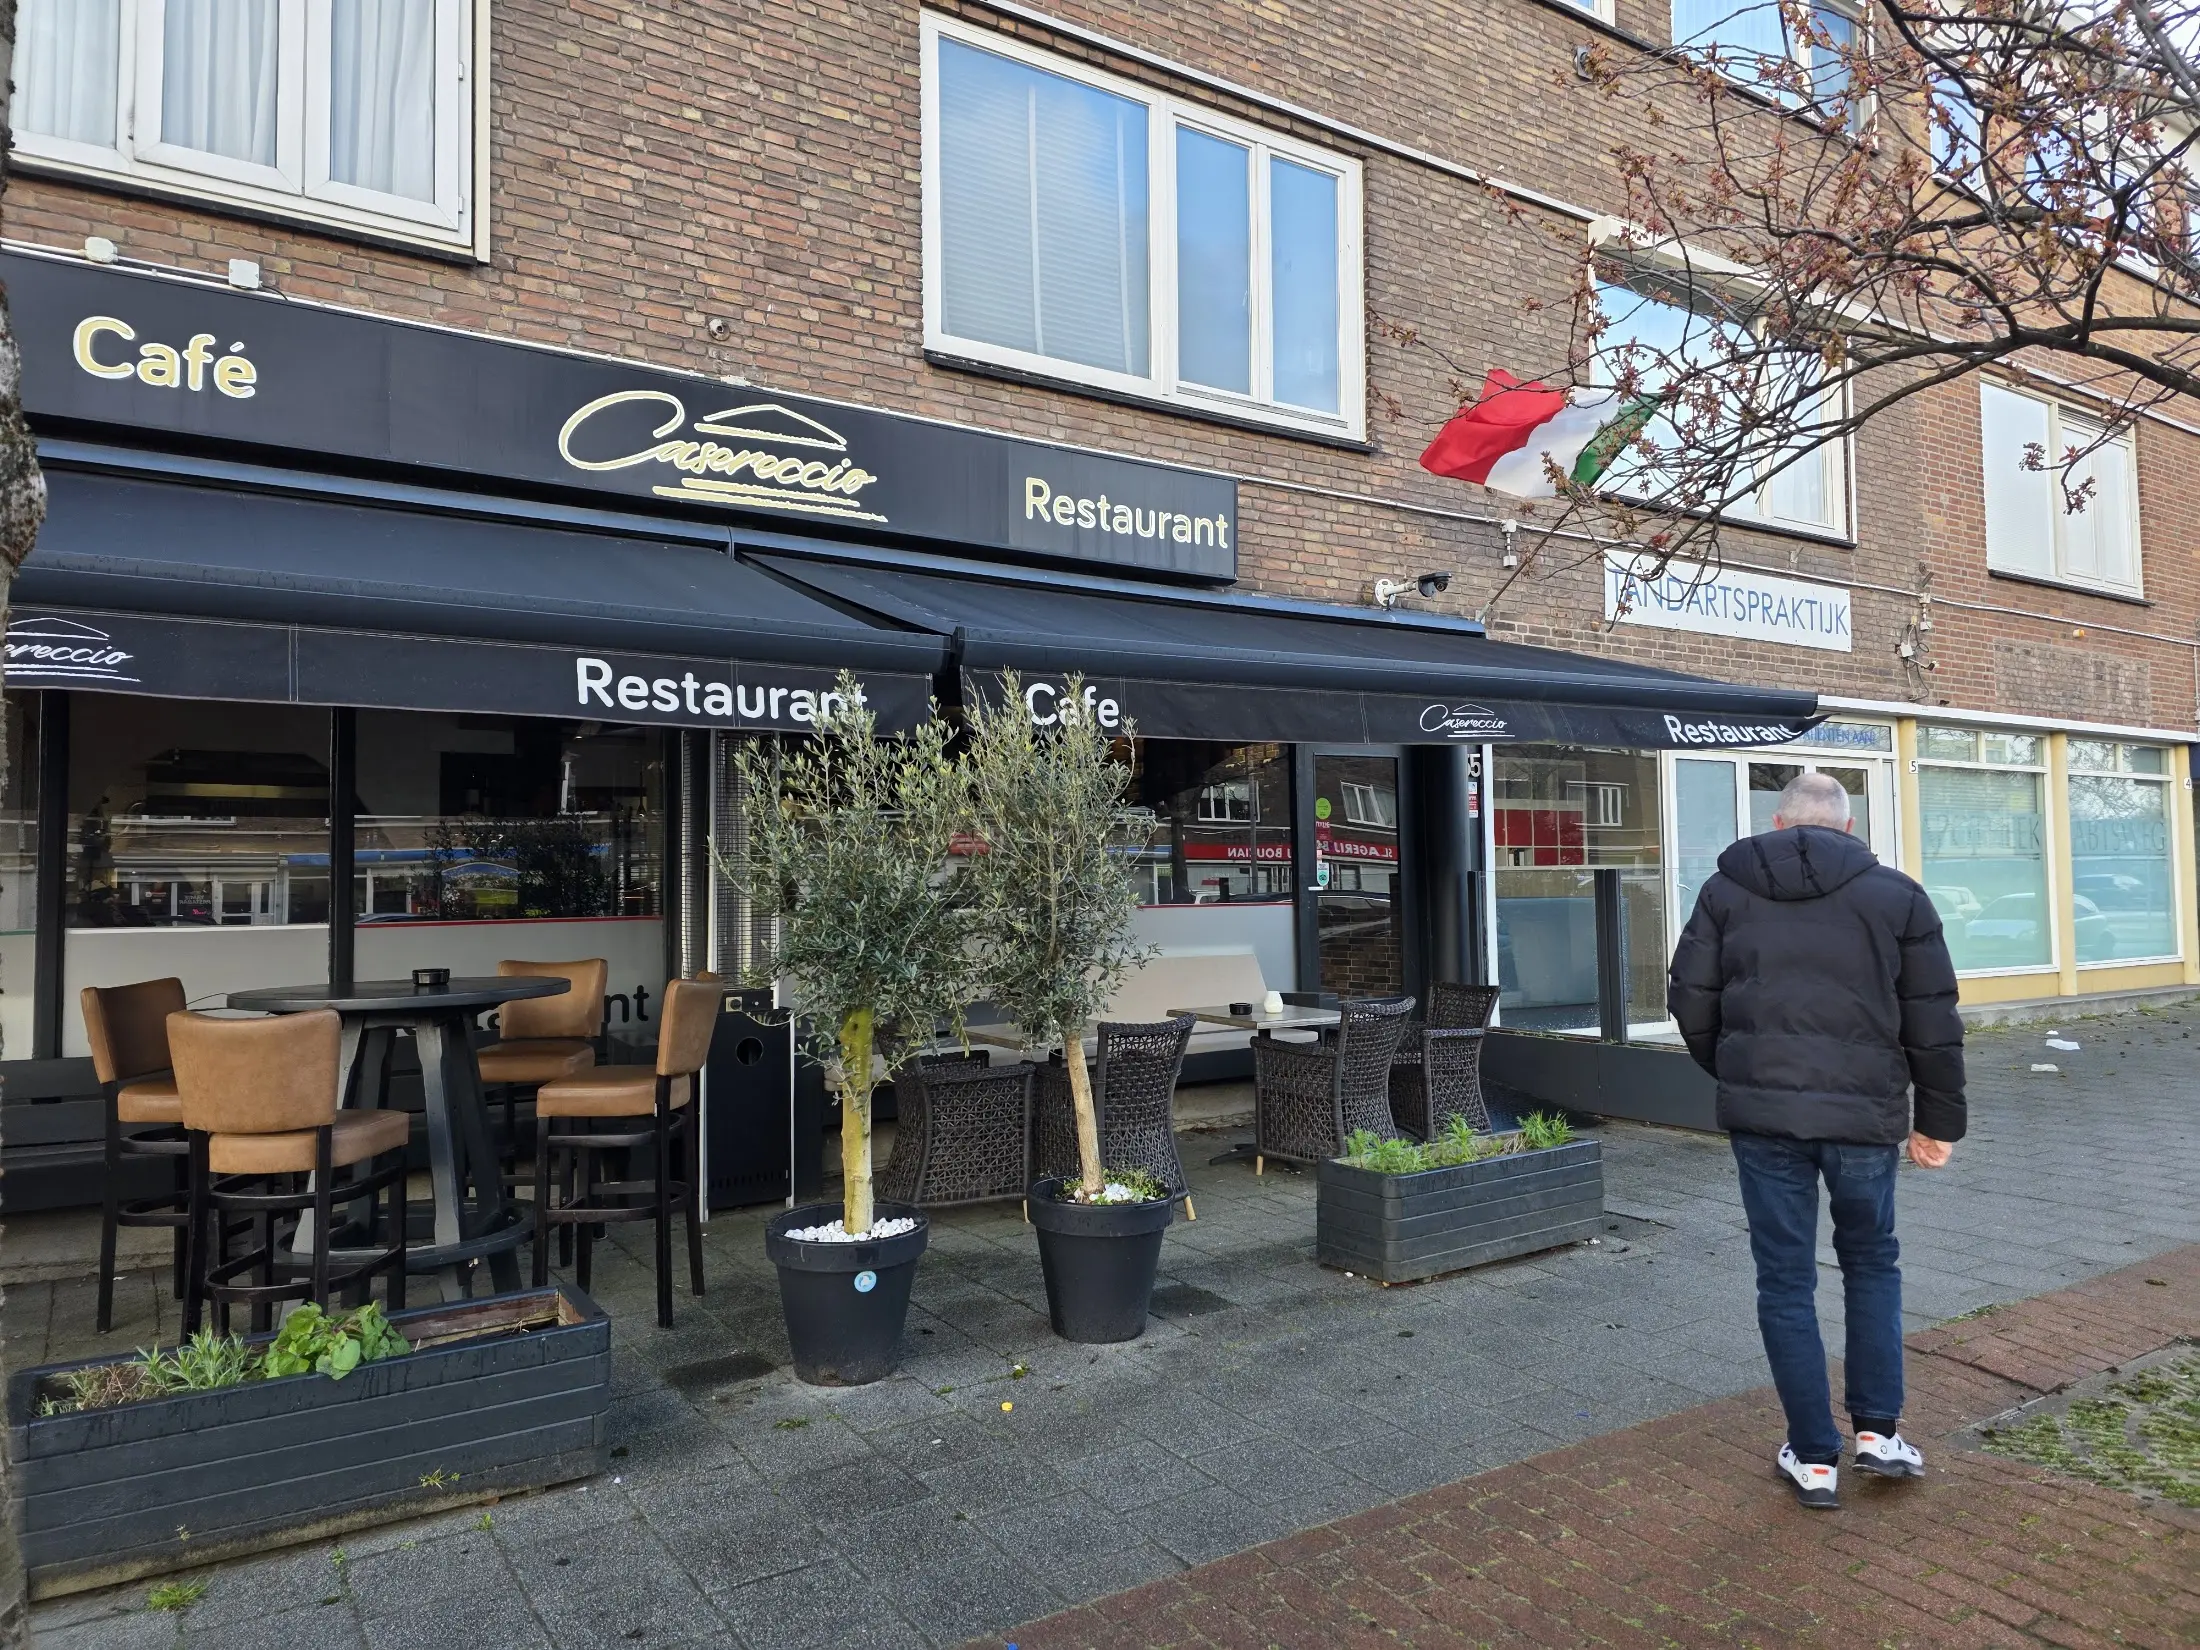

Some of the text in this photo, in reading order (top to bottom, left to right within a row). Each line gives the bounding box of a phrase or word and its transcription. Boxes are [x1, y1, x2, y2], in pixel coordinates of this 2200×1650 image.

[72, 315, 257, 398] Café
[558, 390, 879, 495] Casereccio
[1025, 477, 1229, 548] Restaurant
[1606, 568, 1849, 636] TANDARTSPRAKTIJK
[1419, 704, 1508, 732] Casereccio
[1663, 714, 1803, 743] Restaurant
[1911, 760, 1917, 772] 5
[2185, 778, 2191, 789] 4
